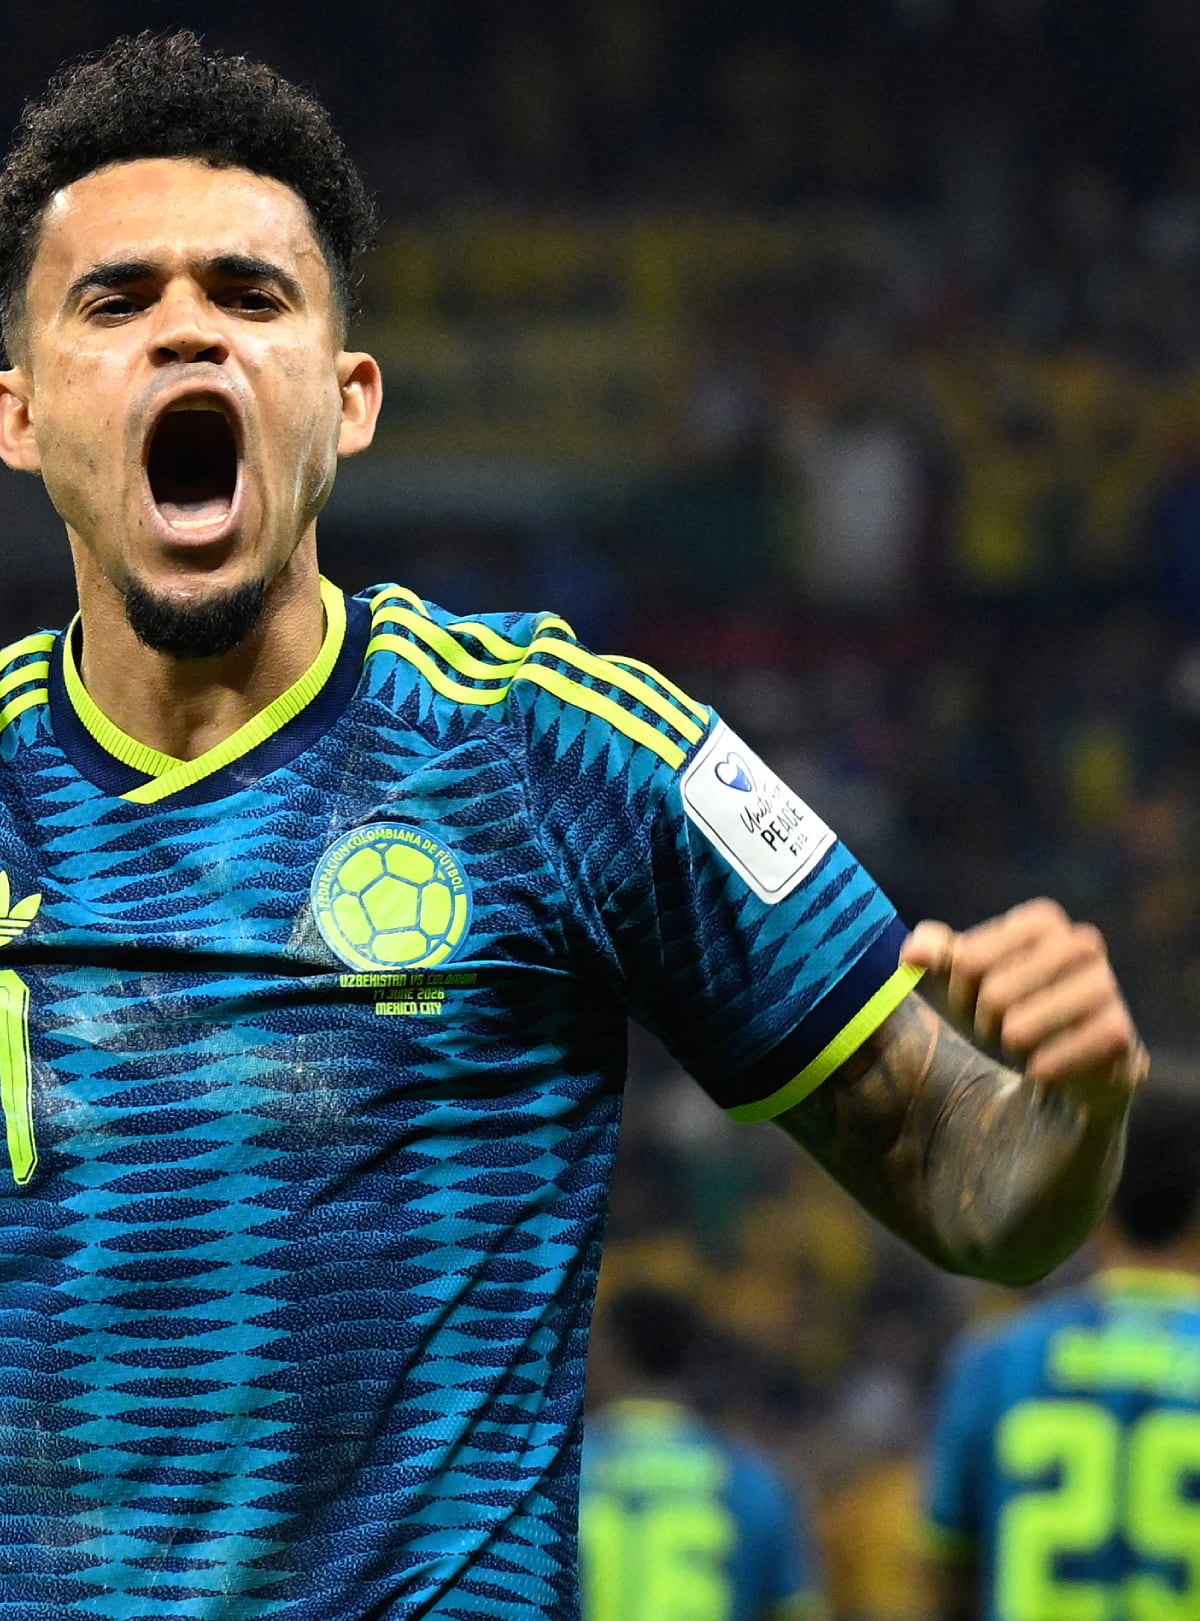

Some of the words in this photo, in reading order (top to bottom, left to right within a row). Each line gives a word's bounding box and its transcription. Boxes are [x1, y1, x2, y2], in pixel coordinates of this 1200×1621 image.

[761, 801, 804, 852] PEACE
[346, 828, 421, 849] COLOMBIANA
[421, 840, 438, 855] DE
[340, 974, 407, 988] UZBEKISTAN
[410, 973, 424, 986] VS
[426, 972, 478, 985] COLOMBIA
[373, 989, 385, 1001] 17
[386, 988, 415, 1000] JUNE
[417, 987, 446, 1000] 2026
[375, 1001, 418, 1016] MEXICO
[419, 1001, 443, 1016] CITY
